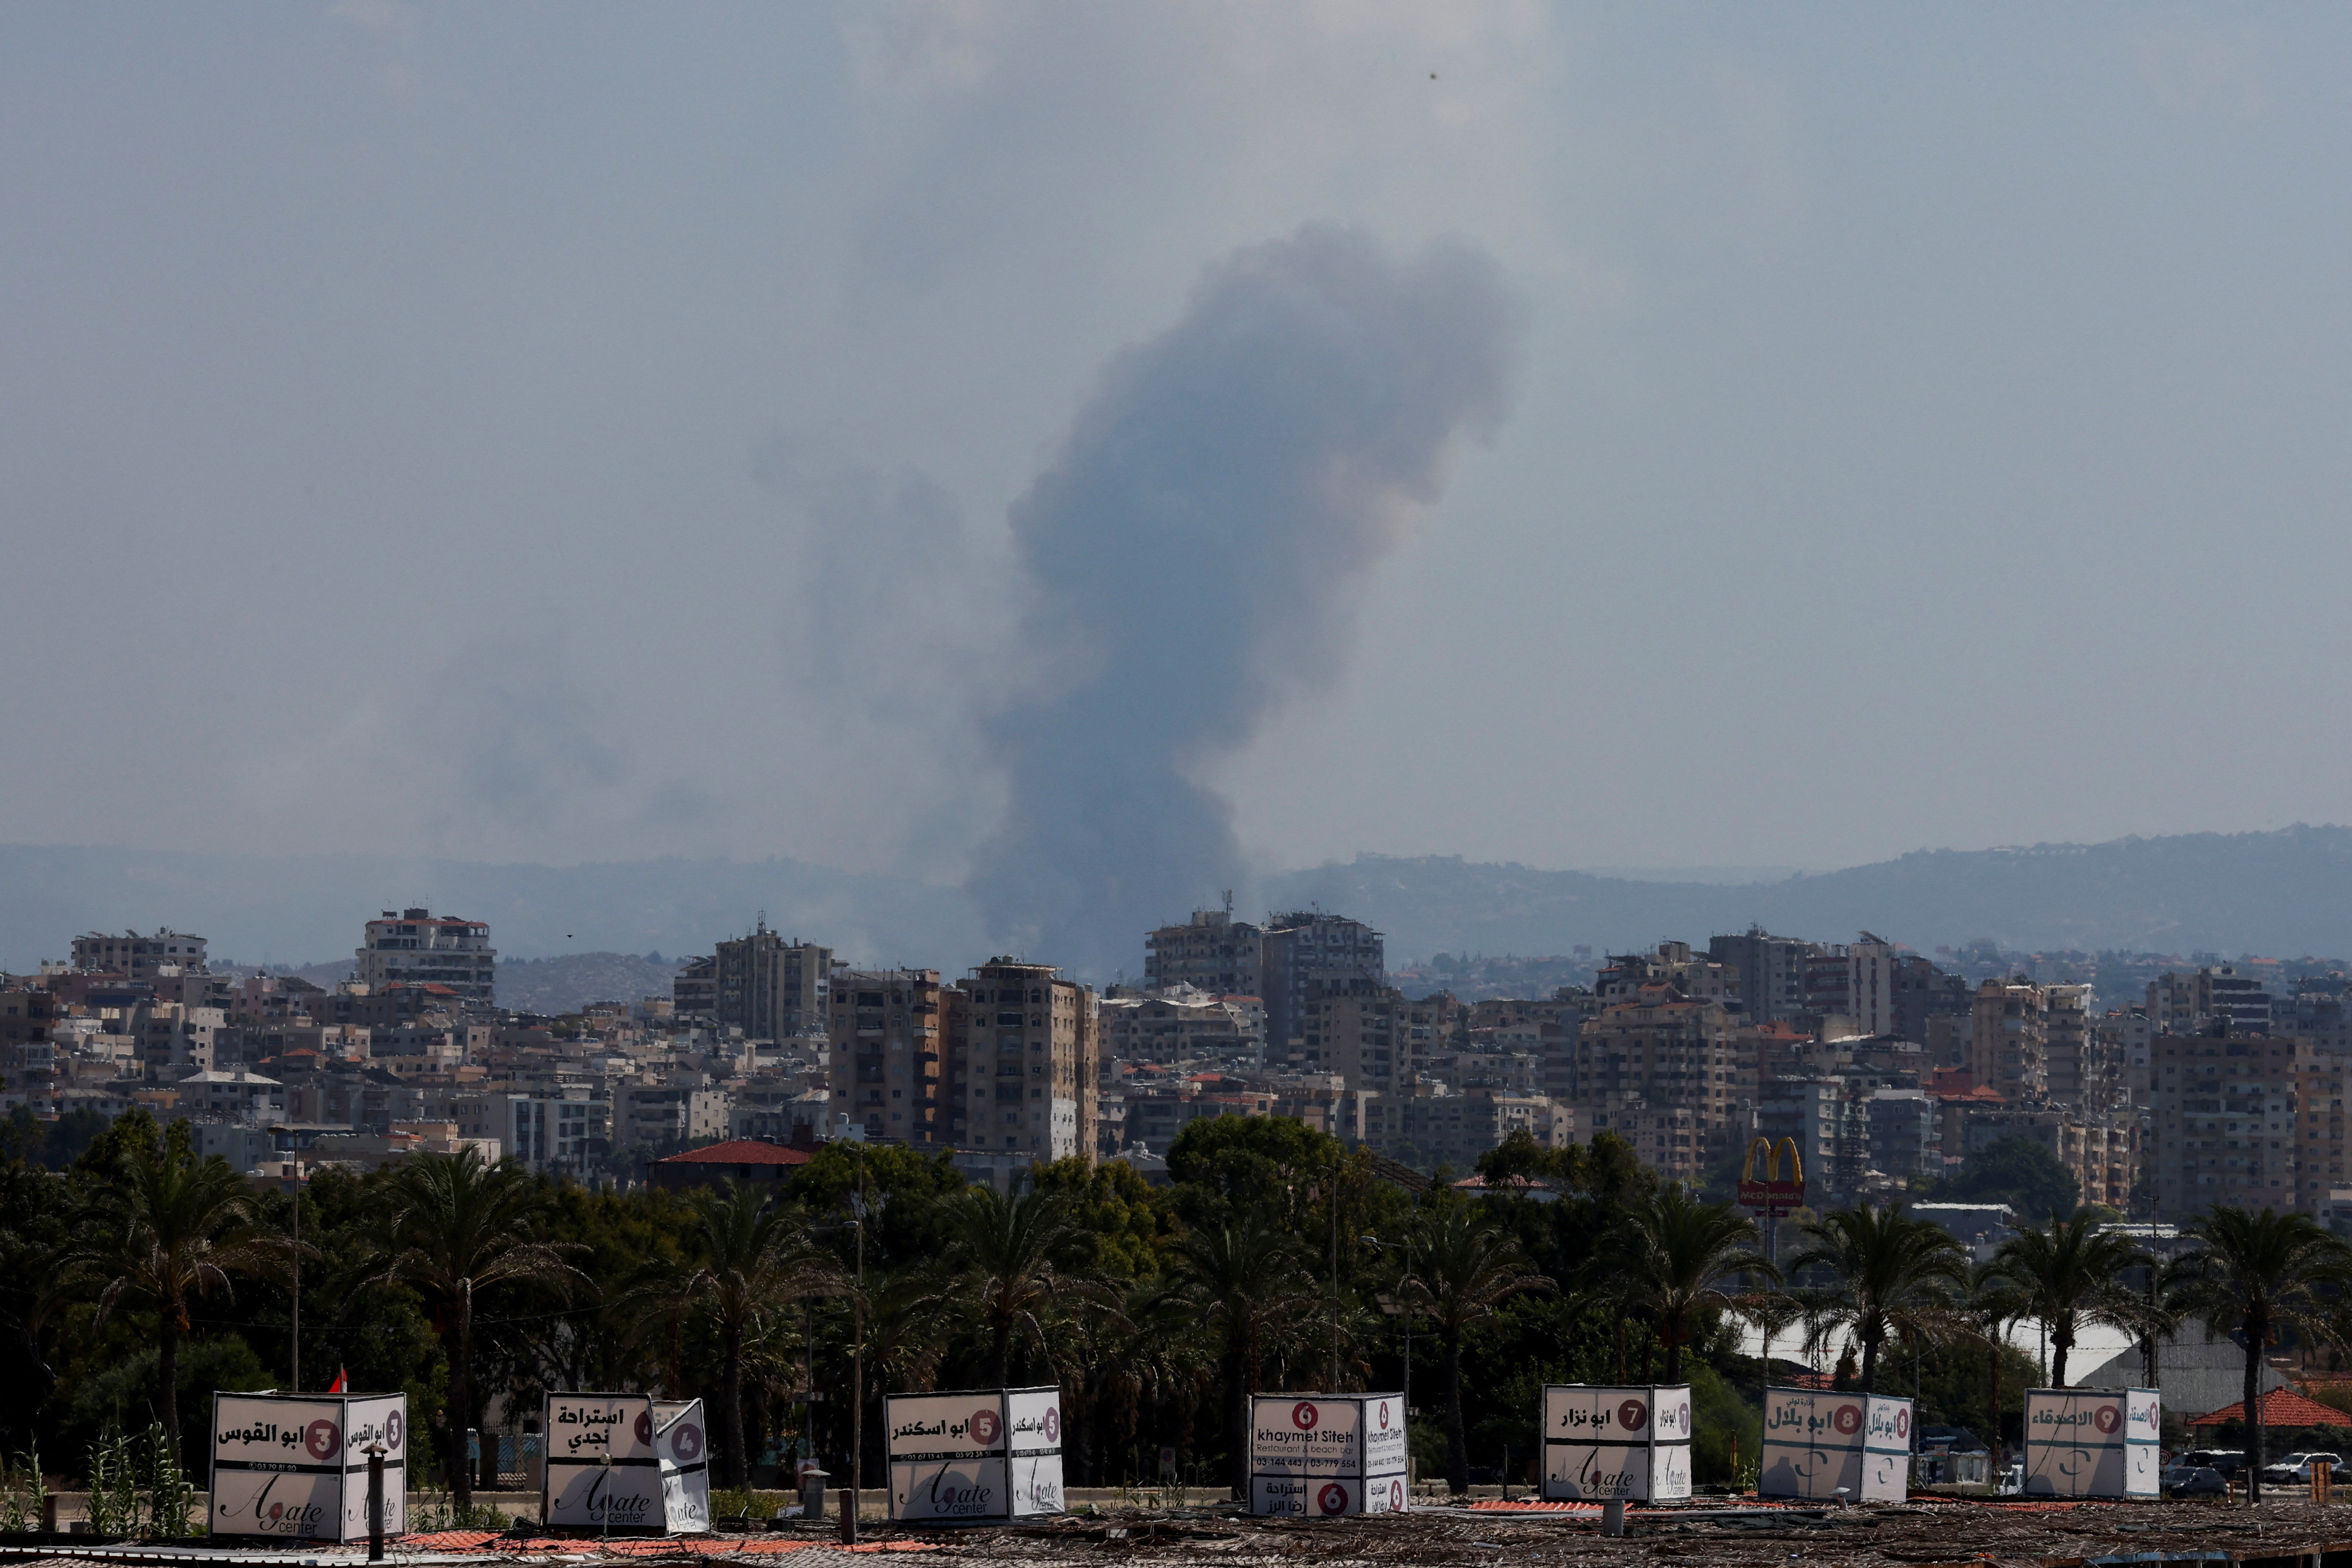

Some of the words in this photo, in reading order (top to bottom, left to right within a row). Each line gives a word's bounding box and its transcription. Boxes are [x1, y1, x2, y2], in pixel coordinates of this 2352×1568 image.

[558, 1406, 624, 1428] استراحة
[1299, 1406, 1312, 1425] 6
[1381, 1405, 1387, 1423] 6
[1561, 1408, 1586, 1426] نزار
[1591, 1409, 1610, 1430] ابو
[1627, 1407, 1638, 1424] 7
[1660, 1409, 1669, 1427] نزار
[1682, 1411, 1687, 1426] 7
[1768, 1407, 1802, 1433] بلال
[1808, 1411, 1832, 1435] ابو
[1842, 1412, 1854, 1427] 8
[2032, 1409, 2093, 1426] الاصدقاء
[2129, 1406, 2149, 1423] الاصدقاء
[390, 1419, 398, 1441] 3
[892, 1420, 945, 1440] اسكندر
[950, 1419, 969, 1439] ابو
[979, 1418, 992, 1436] 5
[1013, 1417, 1035, 1436] اسكندر
[1049, 1416, 1055, 1434] 5
[1868, 1413, 1883, 1439] بلال
[1885, 1415, 1896, 1440] ابو
[1900, 1415, 1905, 1432] 8
[218, 1422, 276, 1445] القوس
[281, 1426, 303, 1449] ابو
[315, 1429, 331, 1452] 3
[348, 1423, 373, 1448] القوس
[375, 1423, 384, 1446] ابو
[568, 1429, 608, 1454] نجدي
[679, 1432, 693, 1451] 4
[1258, 1429, 1318, 1443] khaymet
[1322, 1431, 1353, 1443] Siteh
[1390, 1427, 1402, 1440] Siteh
[1257, 1444, 1300, 1453] Restaurant
[1257, 1458, 1286, 1466] 03-144
[1288, 1459, 1302, 1467] 443
[1310, 1459, 1339, 1467] 03-779
[1325, 1487, 1341, 1509] 6
[1393, 1484, 1400, 1506] 6
[1599, 1487, 1630, 1495] center
[953, 1503, 987, 1514] center
[1267, 1500, 1284, 1514] الرز
[1288, 1500, 1307, 1514] رضا
[608, 1512, 646, 1523] center
[279, 1521, 318, 1534] center
